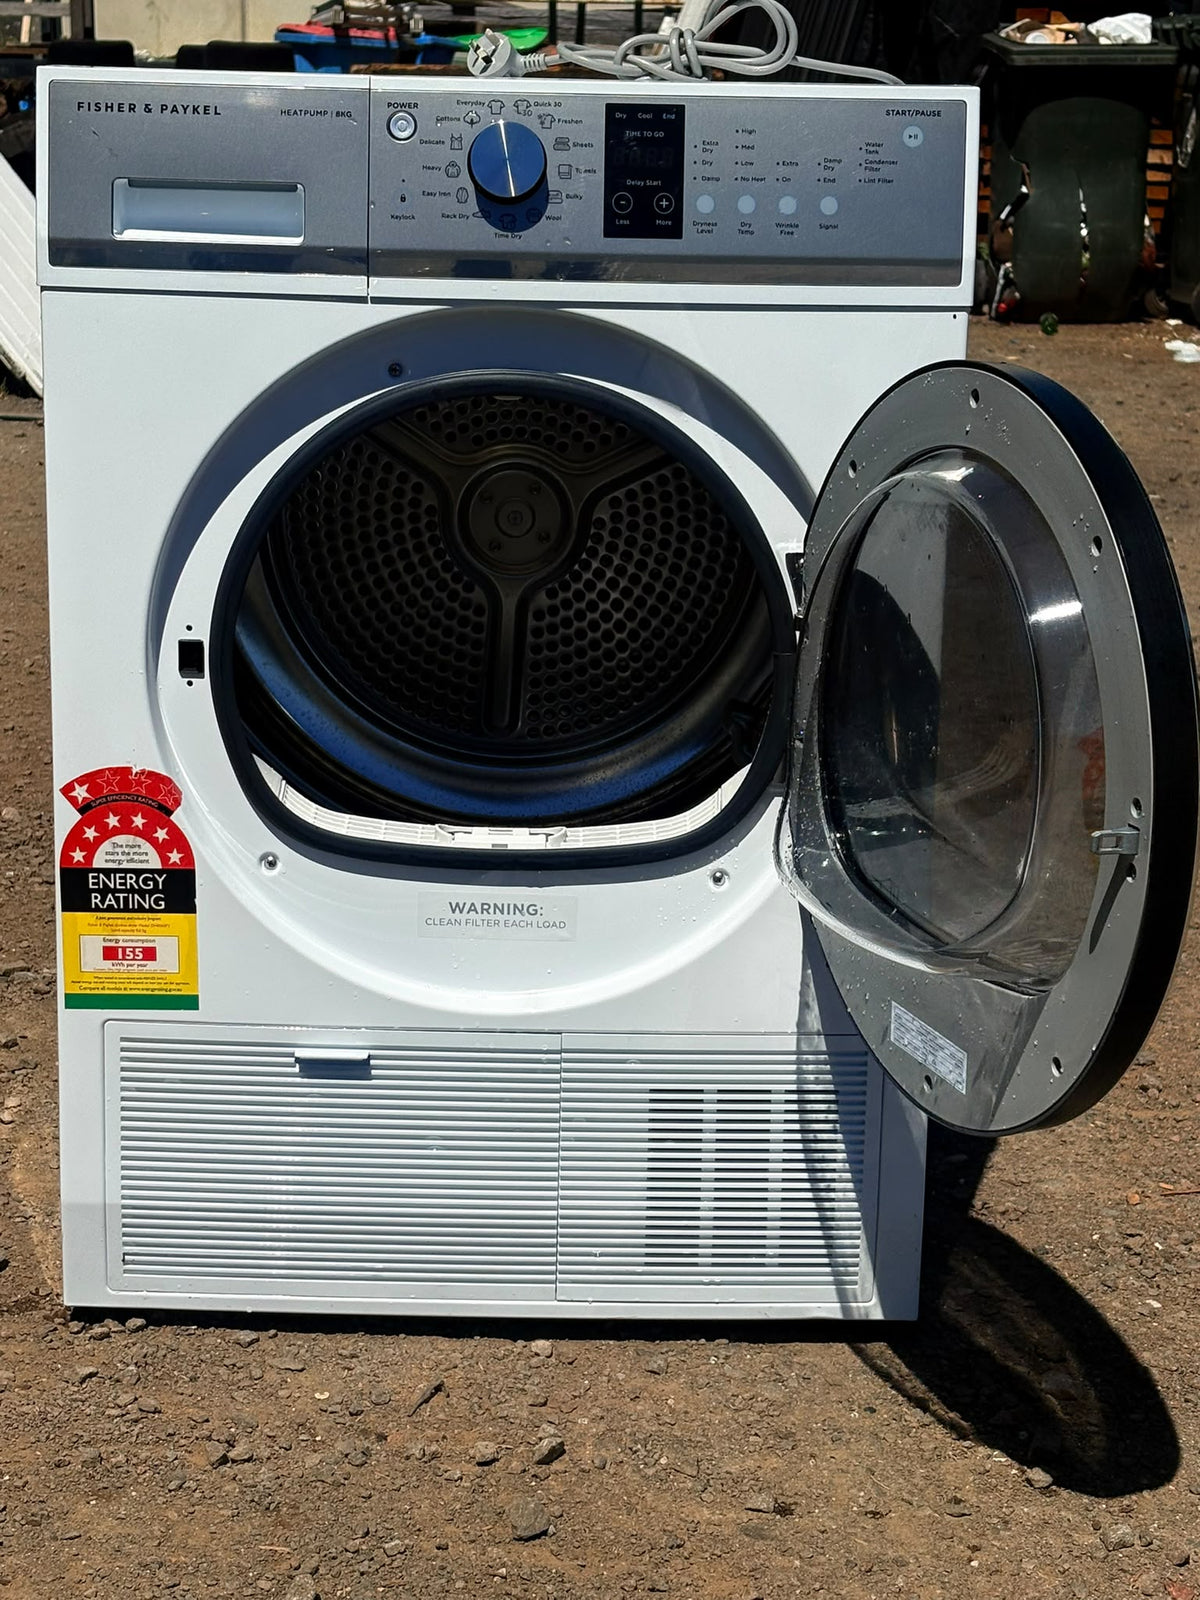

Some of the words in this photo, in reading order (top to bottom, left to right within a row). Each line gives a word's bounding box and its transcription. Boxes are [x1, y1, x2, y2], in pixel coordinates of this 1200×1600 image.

[387, 102, 419, 110] POWER
[456, 100, 486, 108] Everyday
[533, 100, 552, 108] Quick
[77, 101, 137, 114] FISHER
[143, 103, 153, 114] &
[160, 104, 222, 116] PAYKEL
[522, 108, 533, 117] 30
[280, 108, 329, 118] HEATPUMP
[335, 110, 353, 119] 8KG
[615, 112, 627, 120] Dry
[662, 112, 676, 120] End
[885, 109, 942, 118] START/PAUSE
[741, 128, 757, 136] High
[419, 138, 446, 146] Delicate
[572, 141, 594, 149] Sheets
[422, 164, 442, 172] Heavy
[422, 190, 435, 198] Easy
[436, 190, 451, 198] Iron
[566, 193, 583, 201] Bulky
[390, 214, 416, 222] Keylock
[442, 212, 458, 220] Rack
[692, 220, 718, 228] Dryness
[494, 232, 510, 240] Time
[510, 232, 522, 240] Dry
[738, 228, 755, 236] Temp
[104, 858, 125, 866] energy
[88, 872, 167, 890] ENERGY
[91, 893, 166, 910] RATING
[448, 901, 544, 916] WARNING:
[425, 918, 462, 926] CLEAN
[465, 918, 500, 928] FILTER
[504, 920, 534, 928] EACH
[536, 920, 566, 929] LOAD
[117, 948, 144, 960] 155
